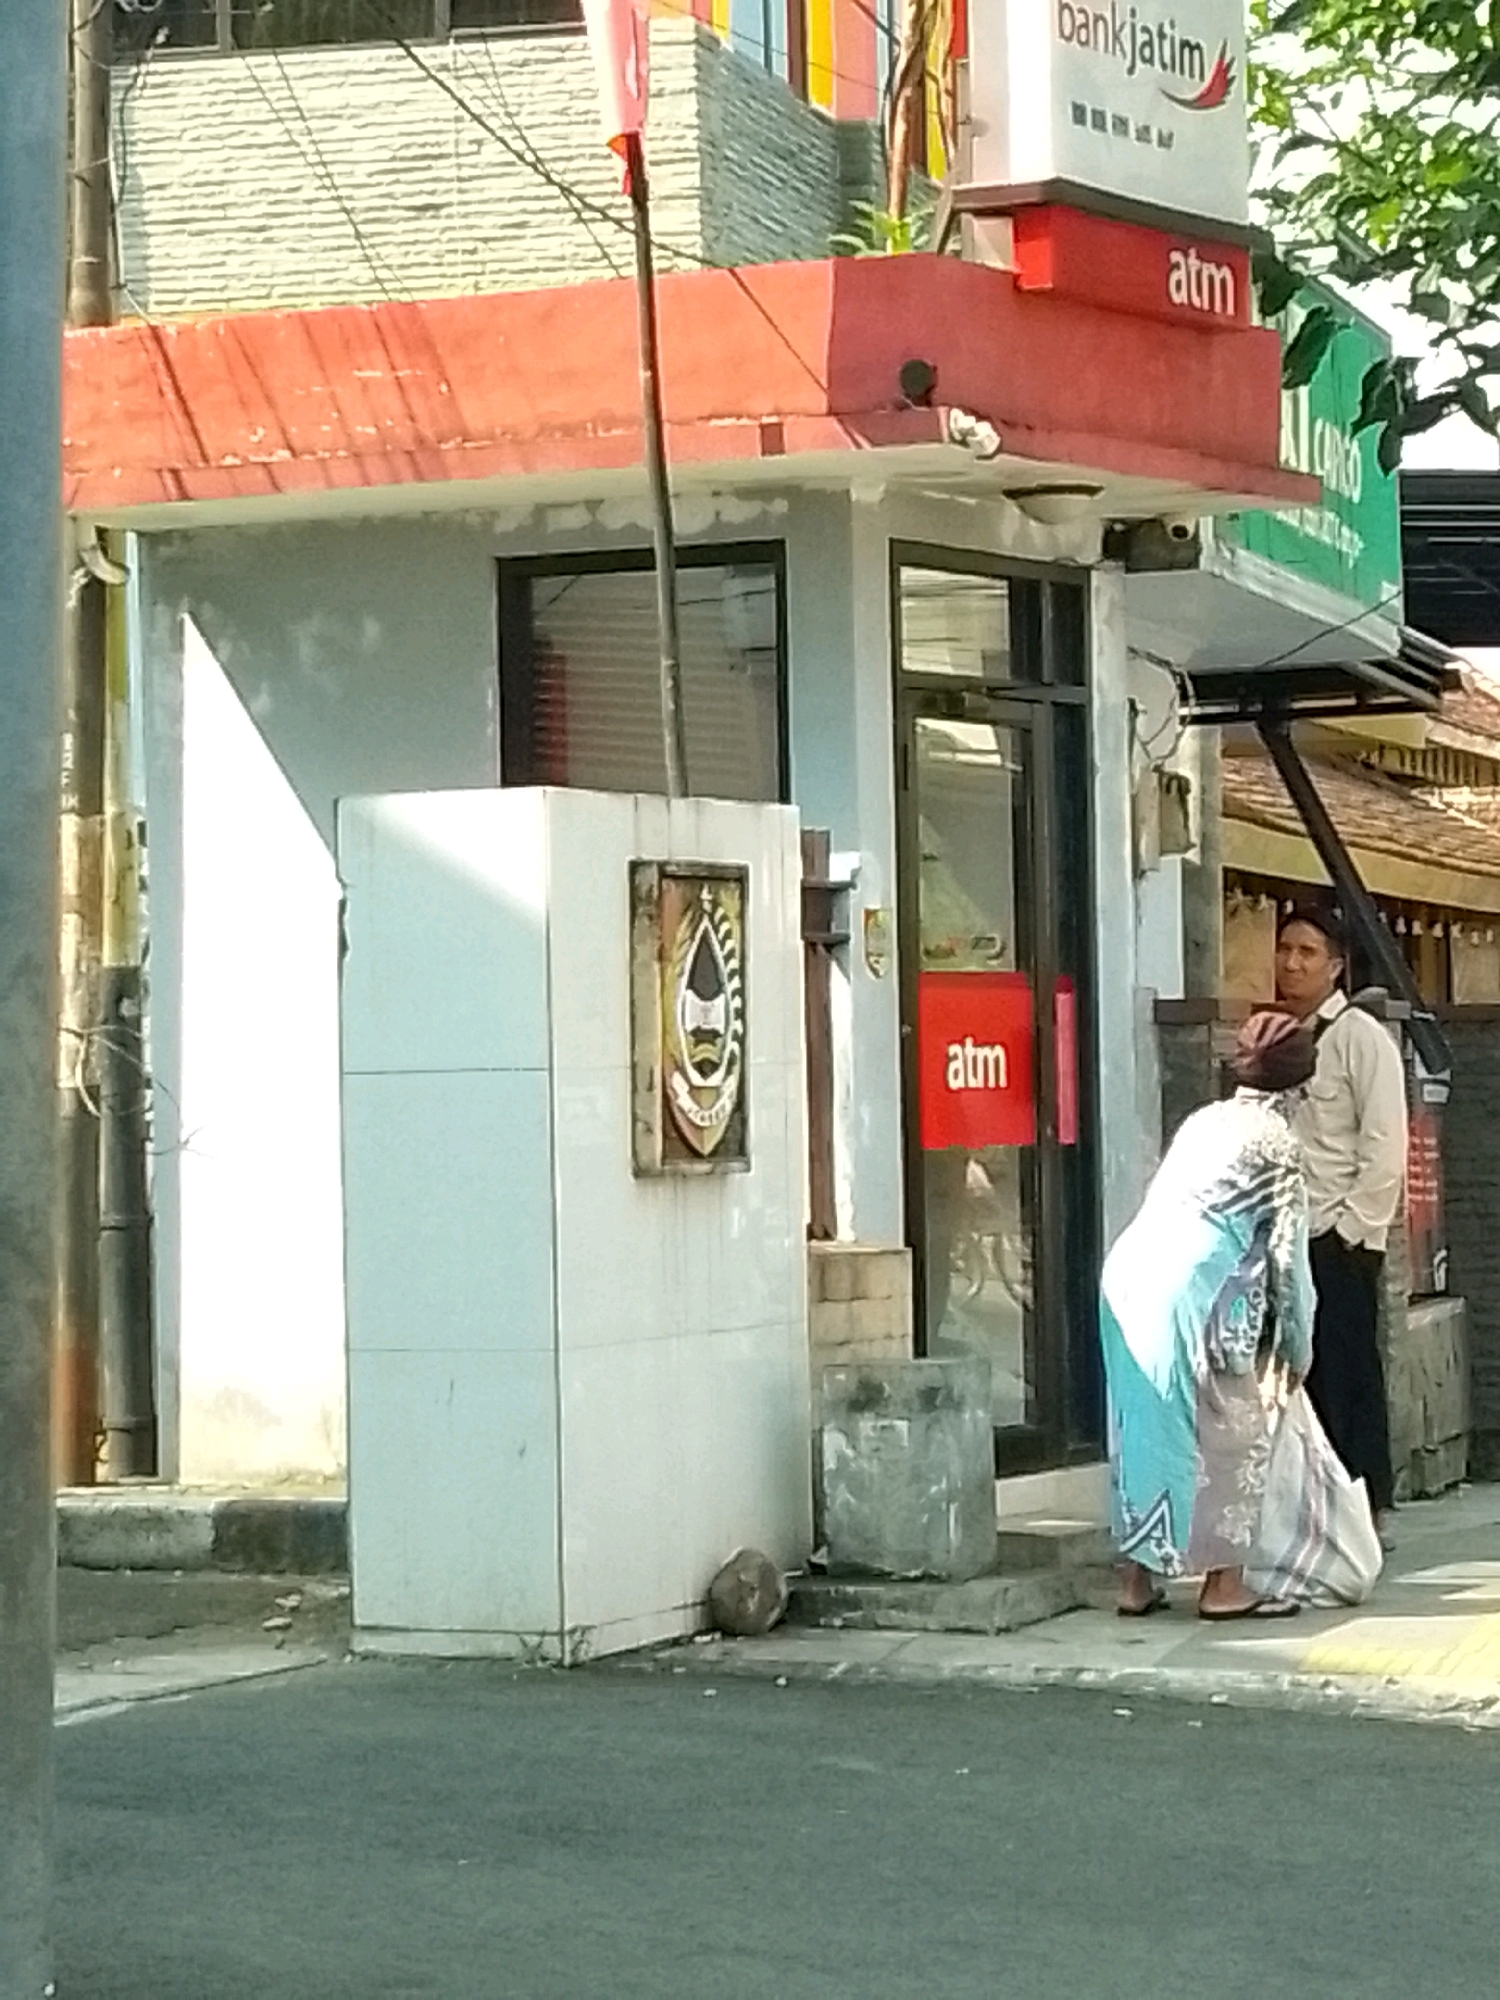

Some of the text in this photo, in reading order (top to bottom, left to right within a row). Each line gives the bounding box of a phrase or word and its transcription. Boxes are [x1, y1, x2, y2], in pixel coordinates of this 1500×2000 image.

[1057, 0, 1206, 82] bankjatim
[1168, 247, 1235, 316] atm
[947, 1036, 1008, 1091] atm
